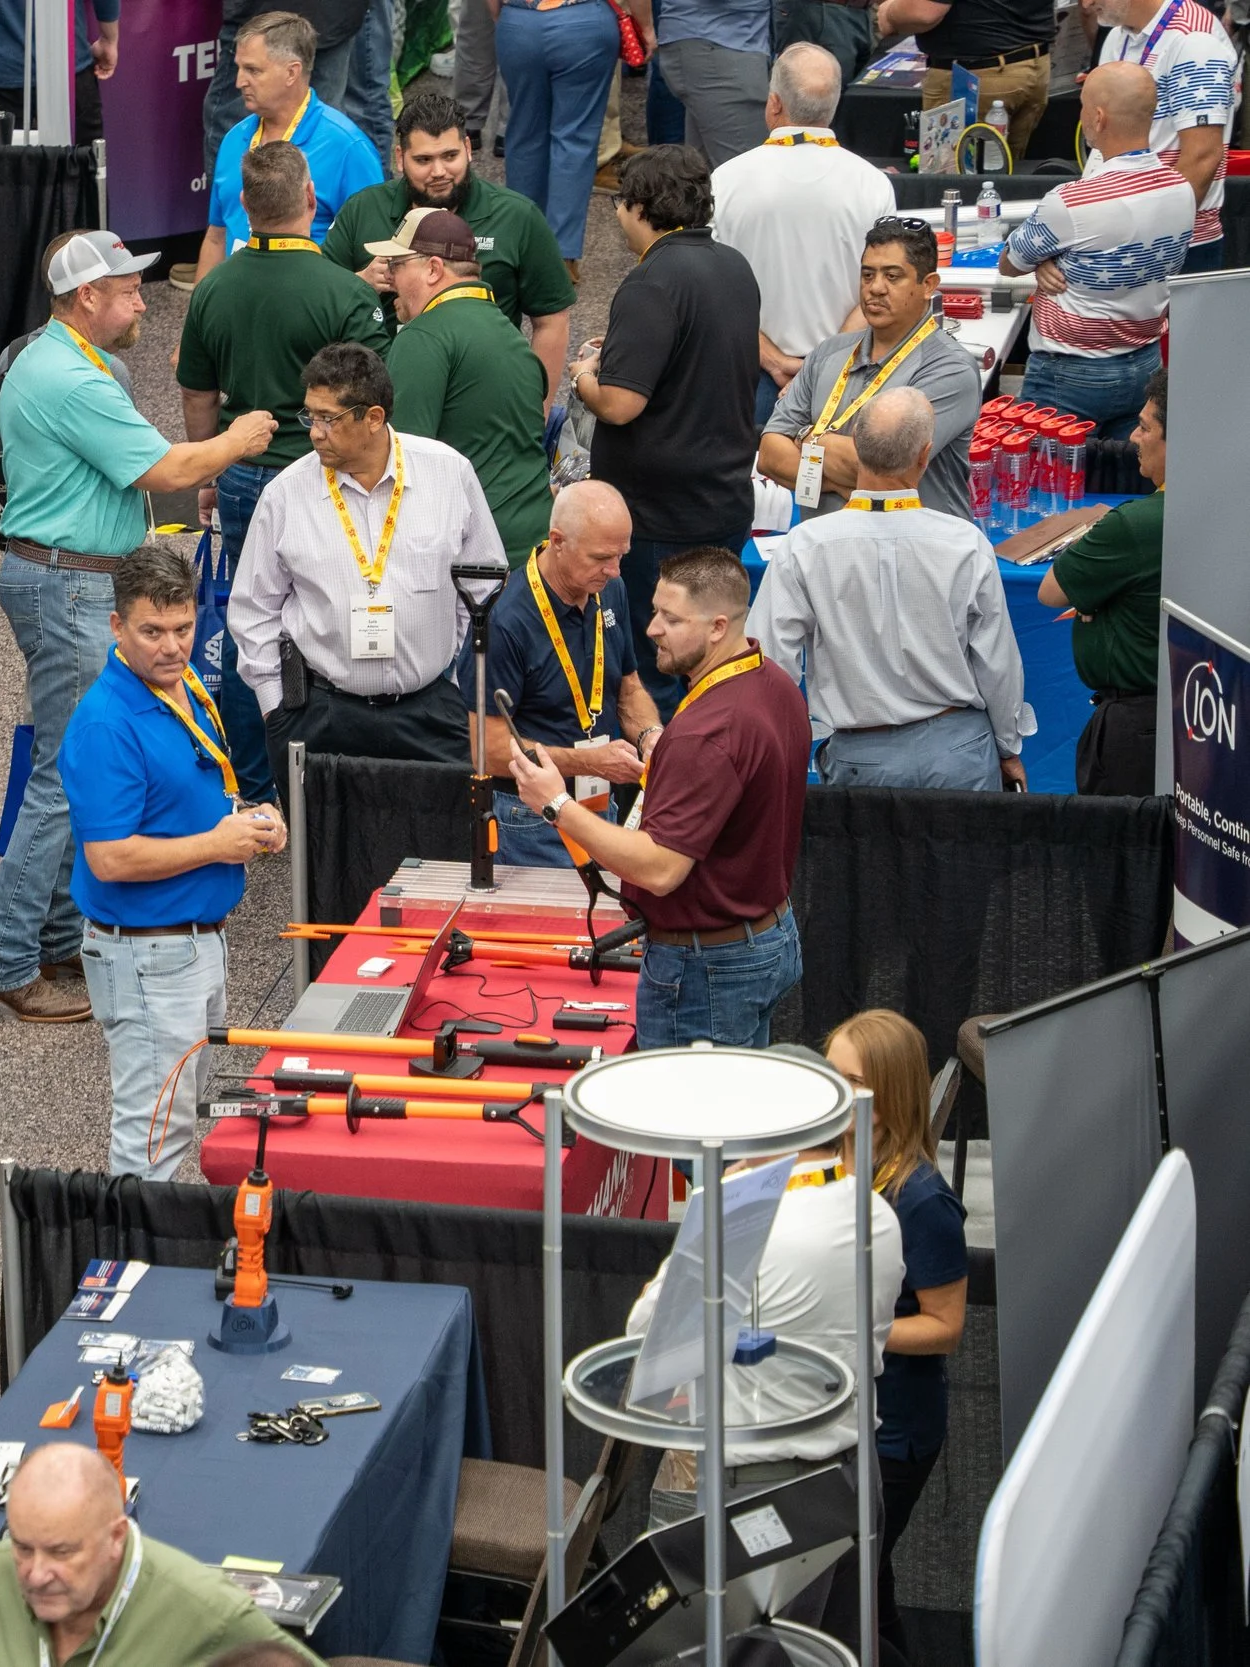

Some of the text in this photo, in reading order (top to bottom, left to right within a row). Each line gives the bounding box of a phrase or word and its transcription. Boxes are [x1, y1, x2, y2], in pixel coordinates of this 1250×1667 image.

[172, 39, 221, 82] TE
[203, 674, 223, 682] STRA
[1188, 672, 1236, 751] ION
[1175, 782, 1250, 844] Portable, Contin
[1187, 818, 1221, 852] Personnel
[1221, 841, 1240, 862] Safe
[234, 1317, 255, 1332] ION
